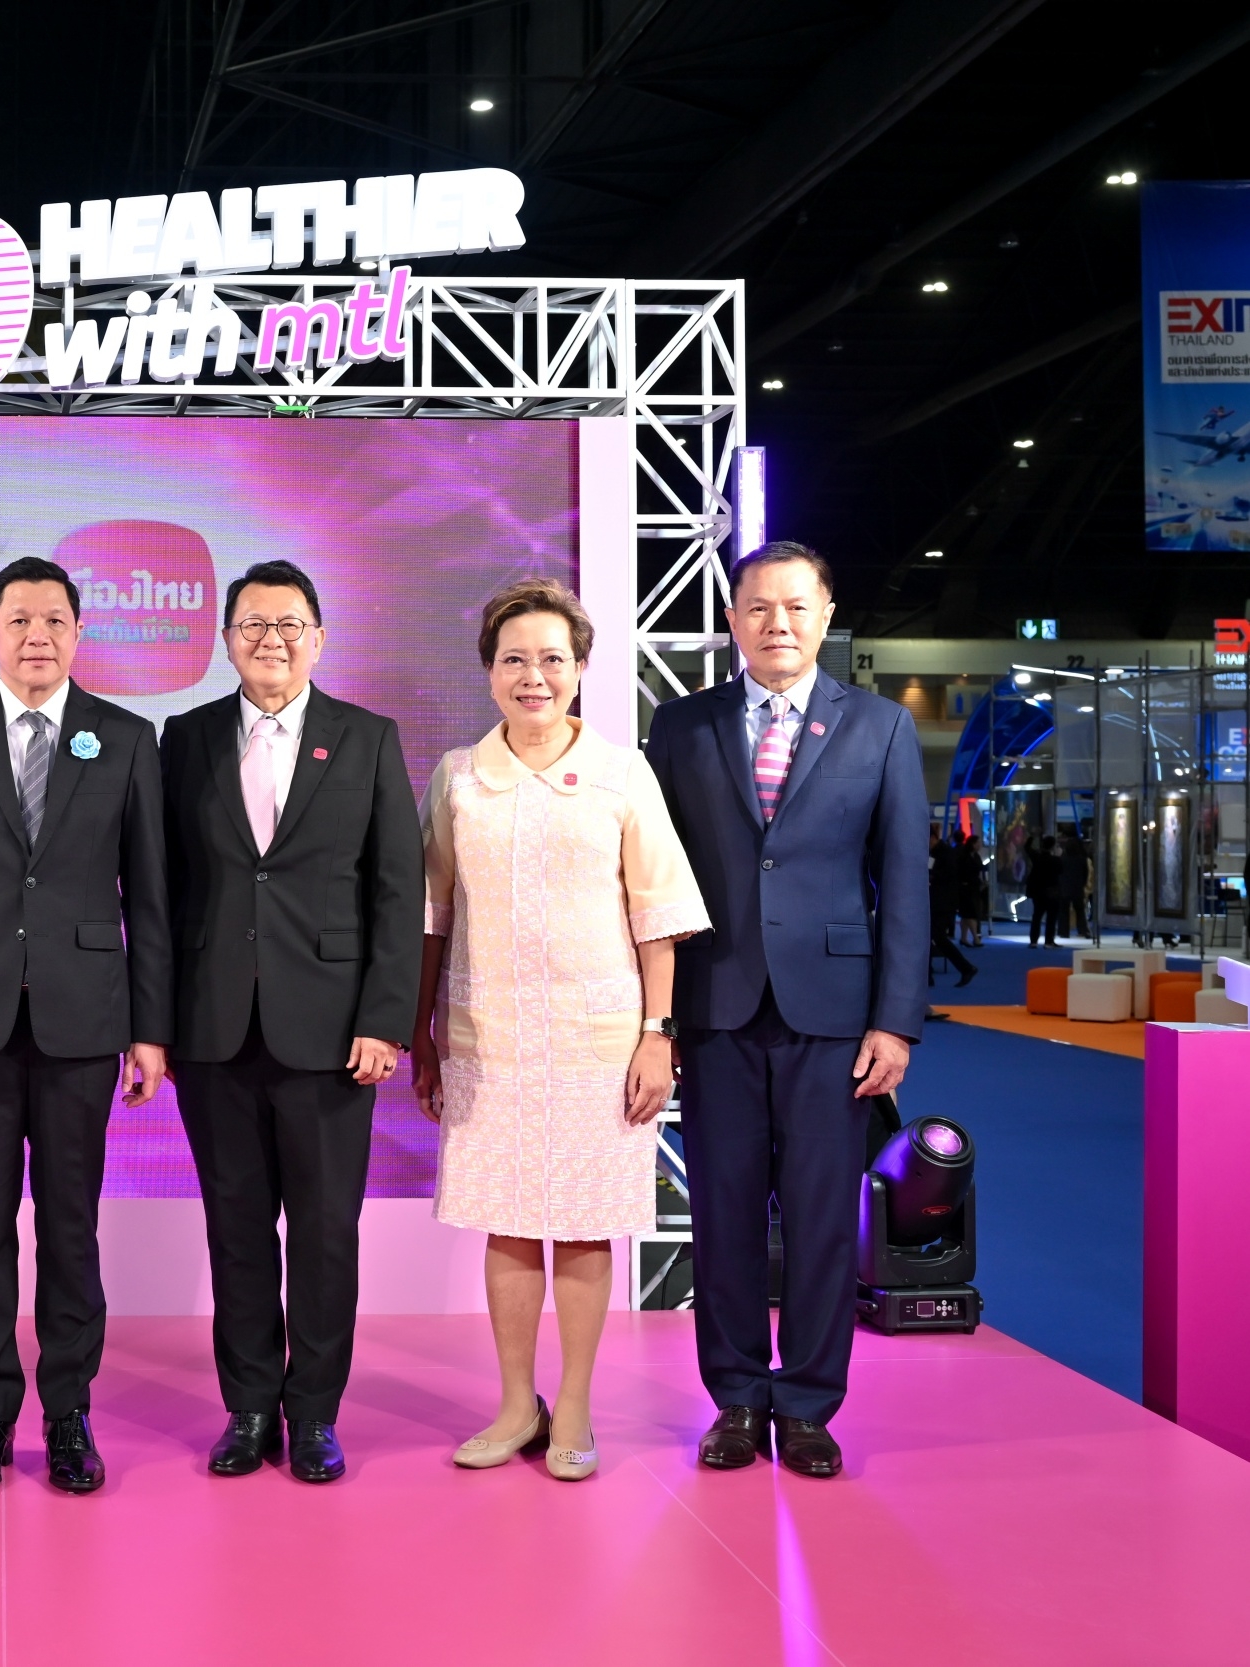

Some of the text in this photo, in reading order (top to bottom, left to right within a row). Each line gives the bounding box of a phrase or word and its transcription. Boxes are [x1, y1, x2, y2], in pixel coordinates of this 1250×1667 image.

[40, 168, 526, 289] HEALTHIER
[44, 265, 412, 390] with mtl
[1168, 334, 1235, 346] THAILAND
[1167, 353, 1250, 366] ธนาคารเพื่อการส่
[80, 617, 190, 643] ระกันชีวิต
[857, 653, 874, 670] 21
[1067, 655, 1086, 669] 22
